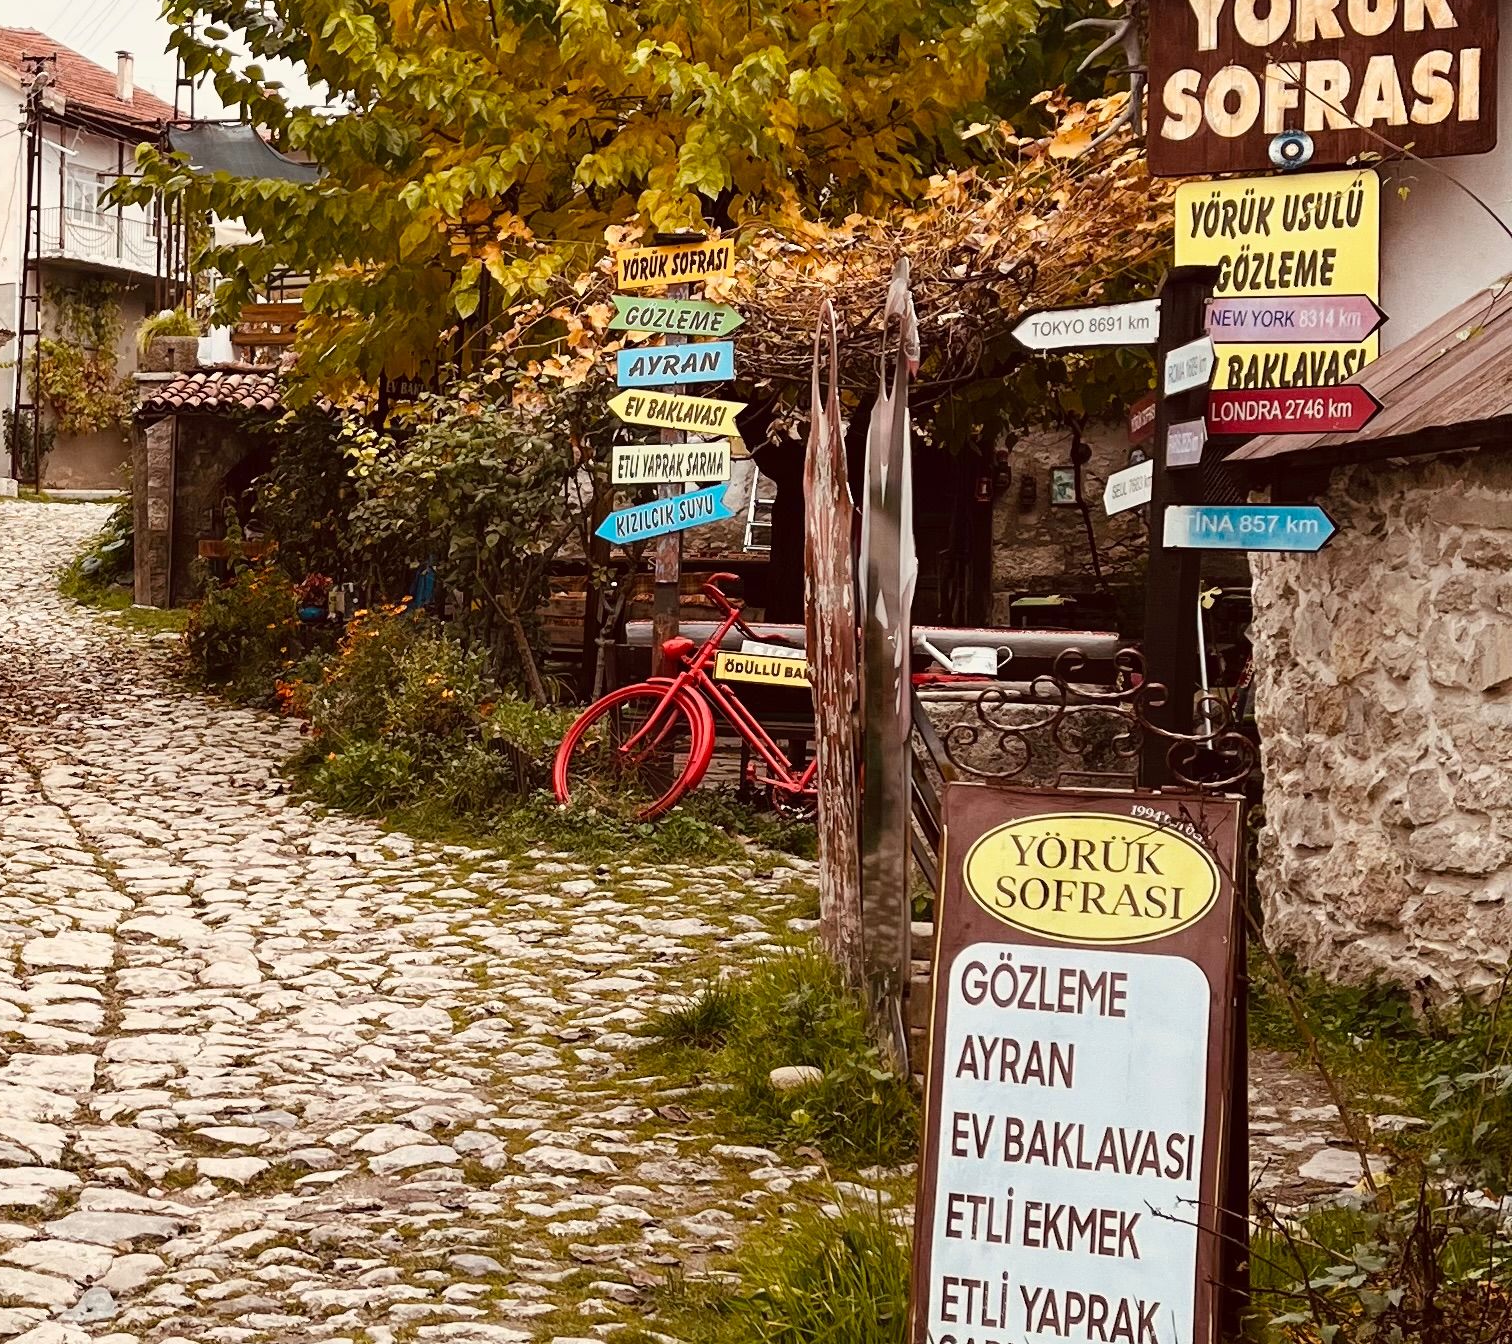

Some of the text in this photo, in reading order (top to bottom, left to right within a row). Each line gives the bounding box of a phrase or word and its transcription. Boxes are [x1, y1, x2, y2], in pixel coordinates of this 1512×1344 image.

[1160, 47, 1481, 142] SOFRASI
[1190, 179, 1364, 239] YÖRÜK USULÜ
[622, 246, 728, 282] YÖRÜK SOFRASI
[1215, 244, 1337, 293] GÖZLEME
[624, 302, 726, 333] GÖZLEME
[1031, 315, 1150, 337] TOKYO 8691 km
[1210, 309, 1362, 328] NEW YORK 8314 km
[628, 350, 722, 379] AYRAN
[1227, 348, 1367, 390] BAKLAVASI
[624, 396, 728, 427] EV BAKLAVASI
[1211, 397, 1353, 422] LONDRA 2746 km
[618, 448, 724, 479] ETLİ YAPRAK SARMA
[616, 494, 714, 537] KIZILCIK SUYU
[1183, 511, 1319, 533] TİNA 857 km
[1009, 831, 1165, 876] YÖRÜK
[994, 873, 1185, 921] SOFRASI
[961, 952, 1128, 1018] GÖZLEME
[956, 1035, 1075, 1089] AYRAN
[951, 1110, 1194, 1181] EV BAKLAVASI
[945, 1186, 1141, 1260] ETLİ EKMEK
[940, 1269, 1008, 1330] ETLİ
